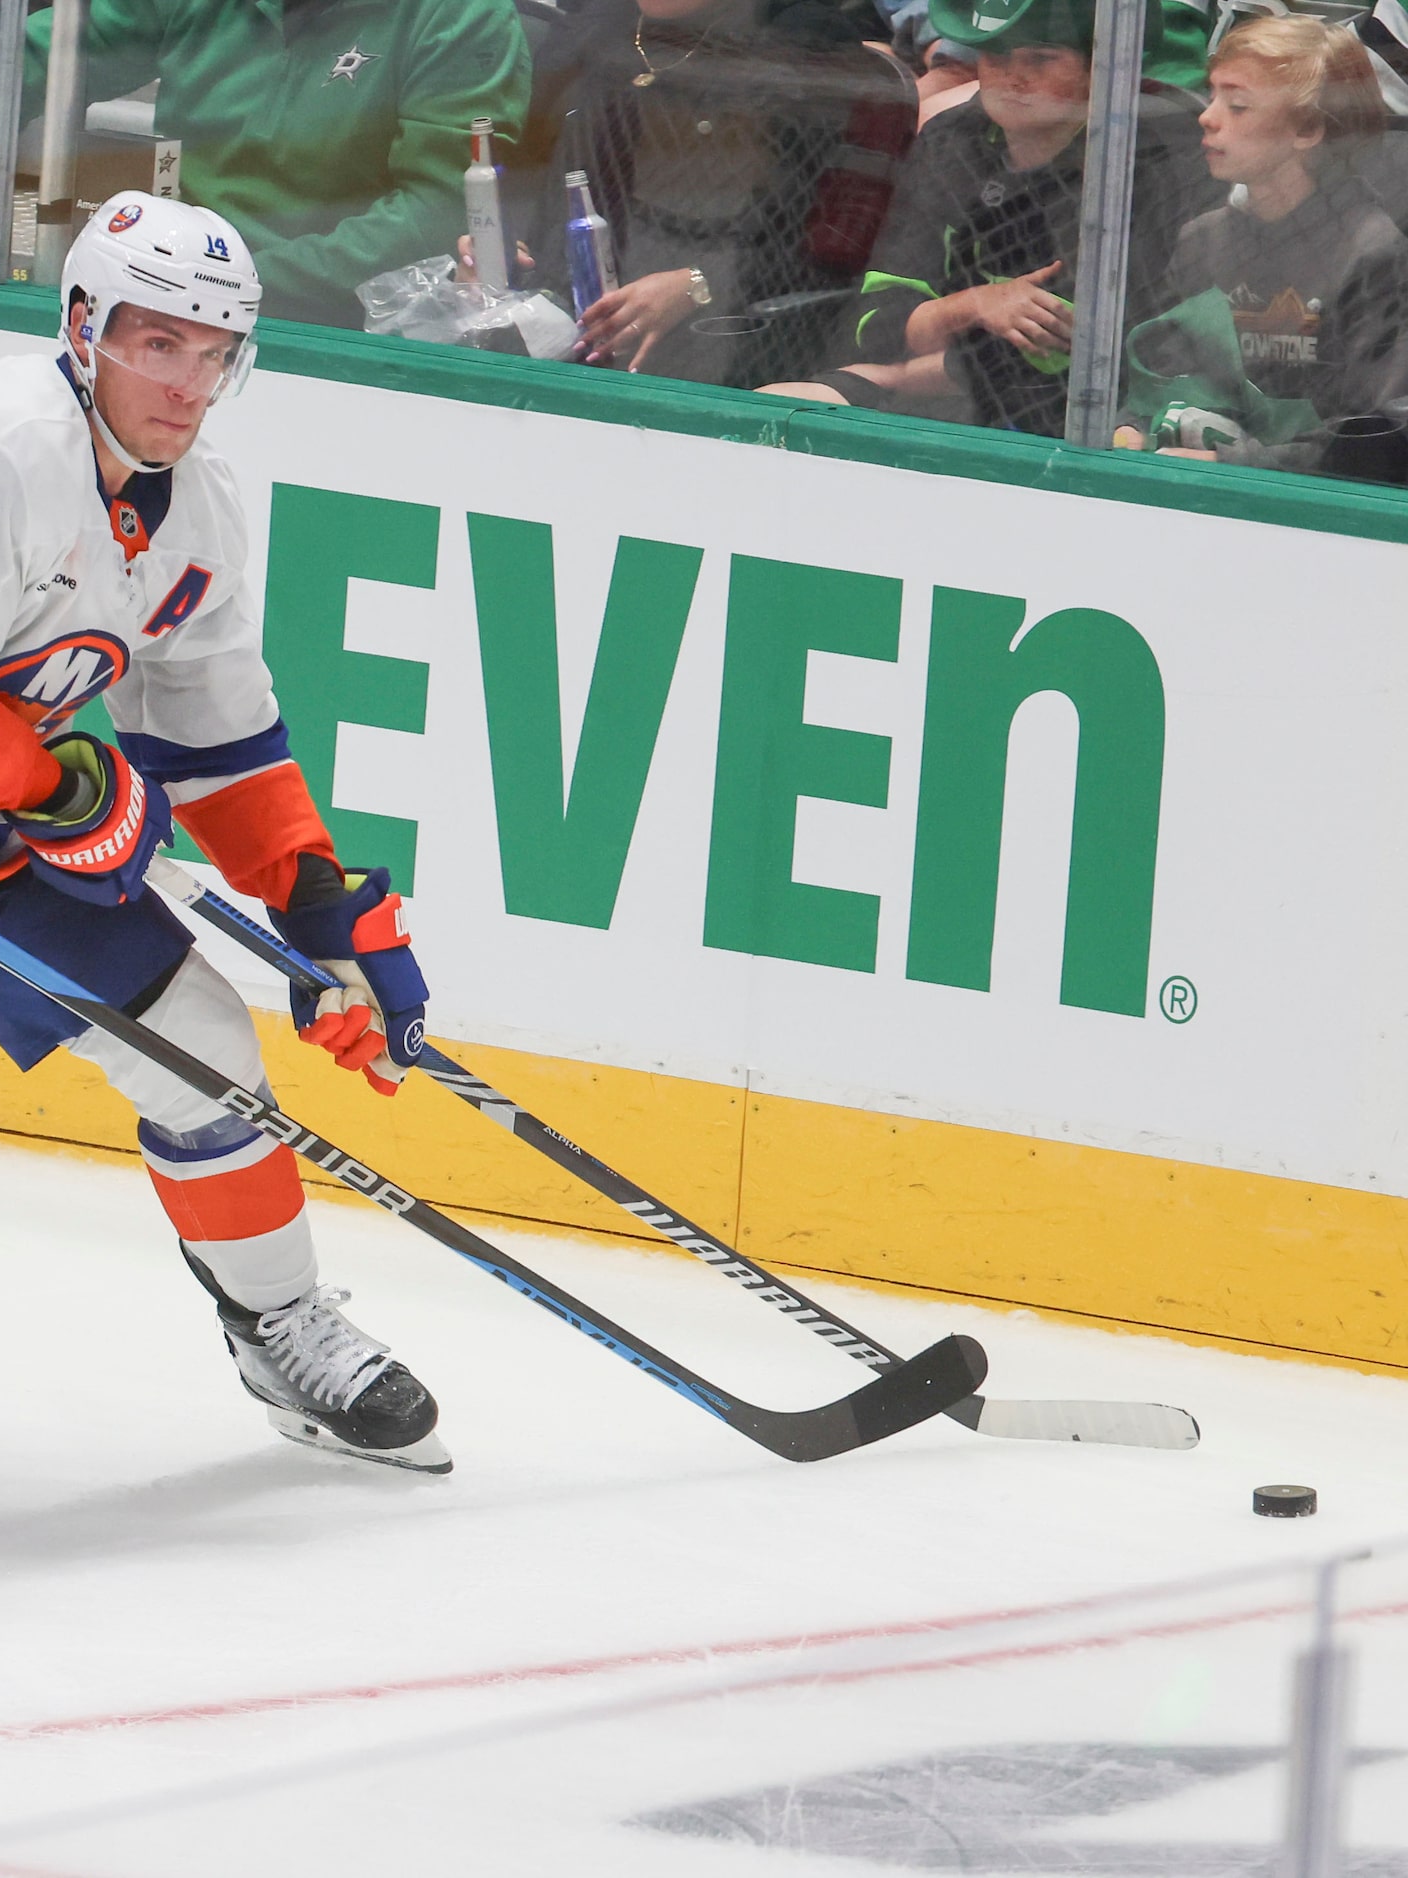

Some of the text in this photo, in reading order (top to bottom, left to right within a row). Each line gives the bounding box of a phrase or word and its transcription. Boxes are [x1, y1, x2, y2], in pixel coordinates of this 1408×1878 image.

[205, 234, 229, 257] 14
[194, 271, 241, 290] WARRIOR
[142, 563, 213, 637] A
[38, 763, 145, 866] WARRIOR
[312, 964, 338, 985] HORVAT
[542, 1126, 582, 1156] ALPHA
[619, 1199, 891, 1377] WARRIOR
